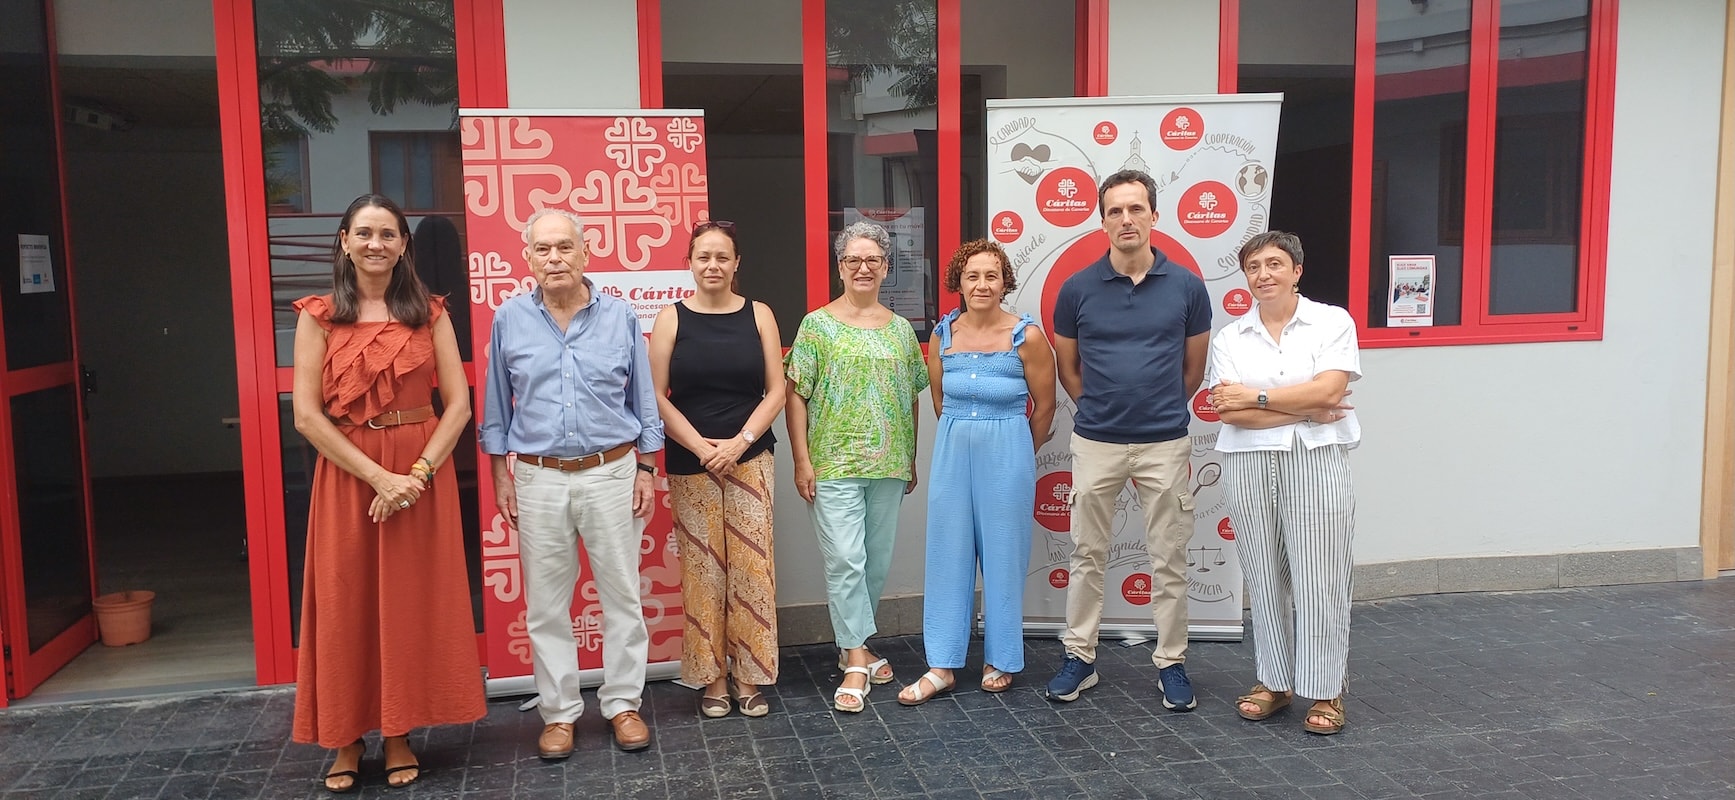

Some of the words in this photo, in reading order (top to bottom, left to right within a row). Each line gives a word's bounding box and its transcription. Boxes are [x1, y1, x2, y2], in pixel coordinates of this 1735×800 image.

[996, 116, 1030, 141] CARIDAD
[1204, 133, 1256, 155] COOPERACIÓN
[1046, 199, 1087, 207] Cáritas
[1187, 211, 1227, 219] Cáritas
[629, 286, 696, 301] Cárita
[1039, 503, 1071, 511] Cárit
[1108, 538, 1148, 560] ignida
[1187, 576, 1223, 596] USTICIA
